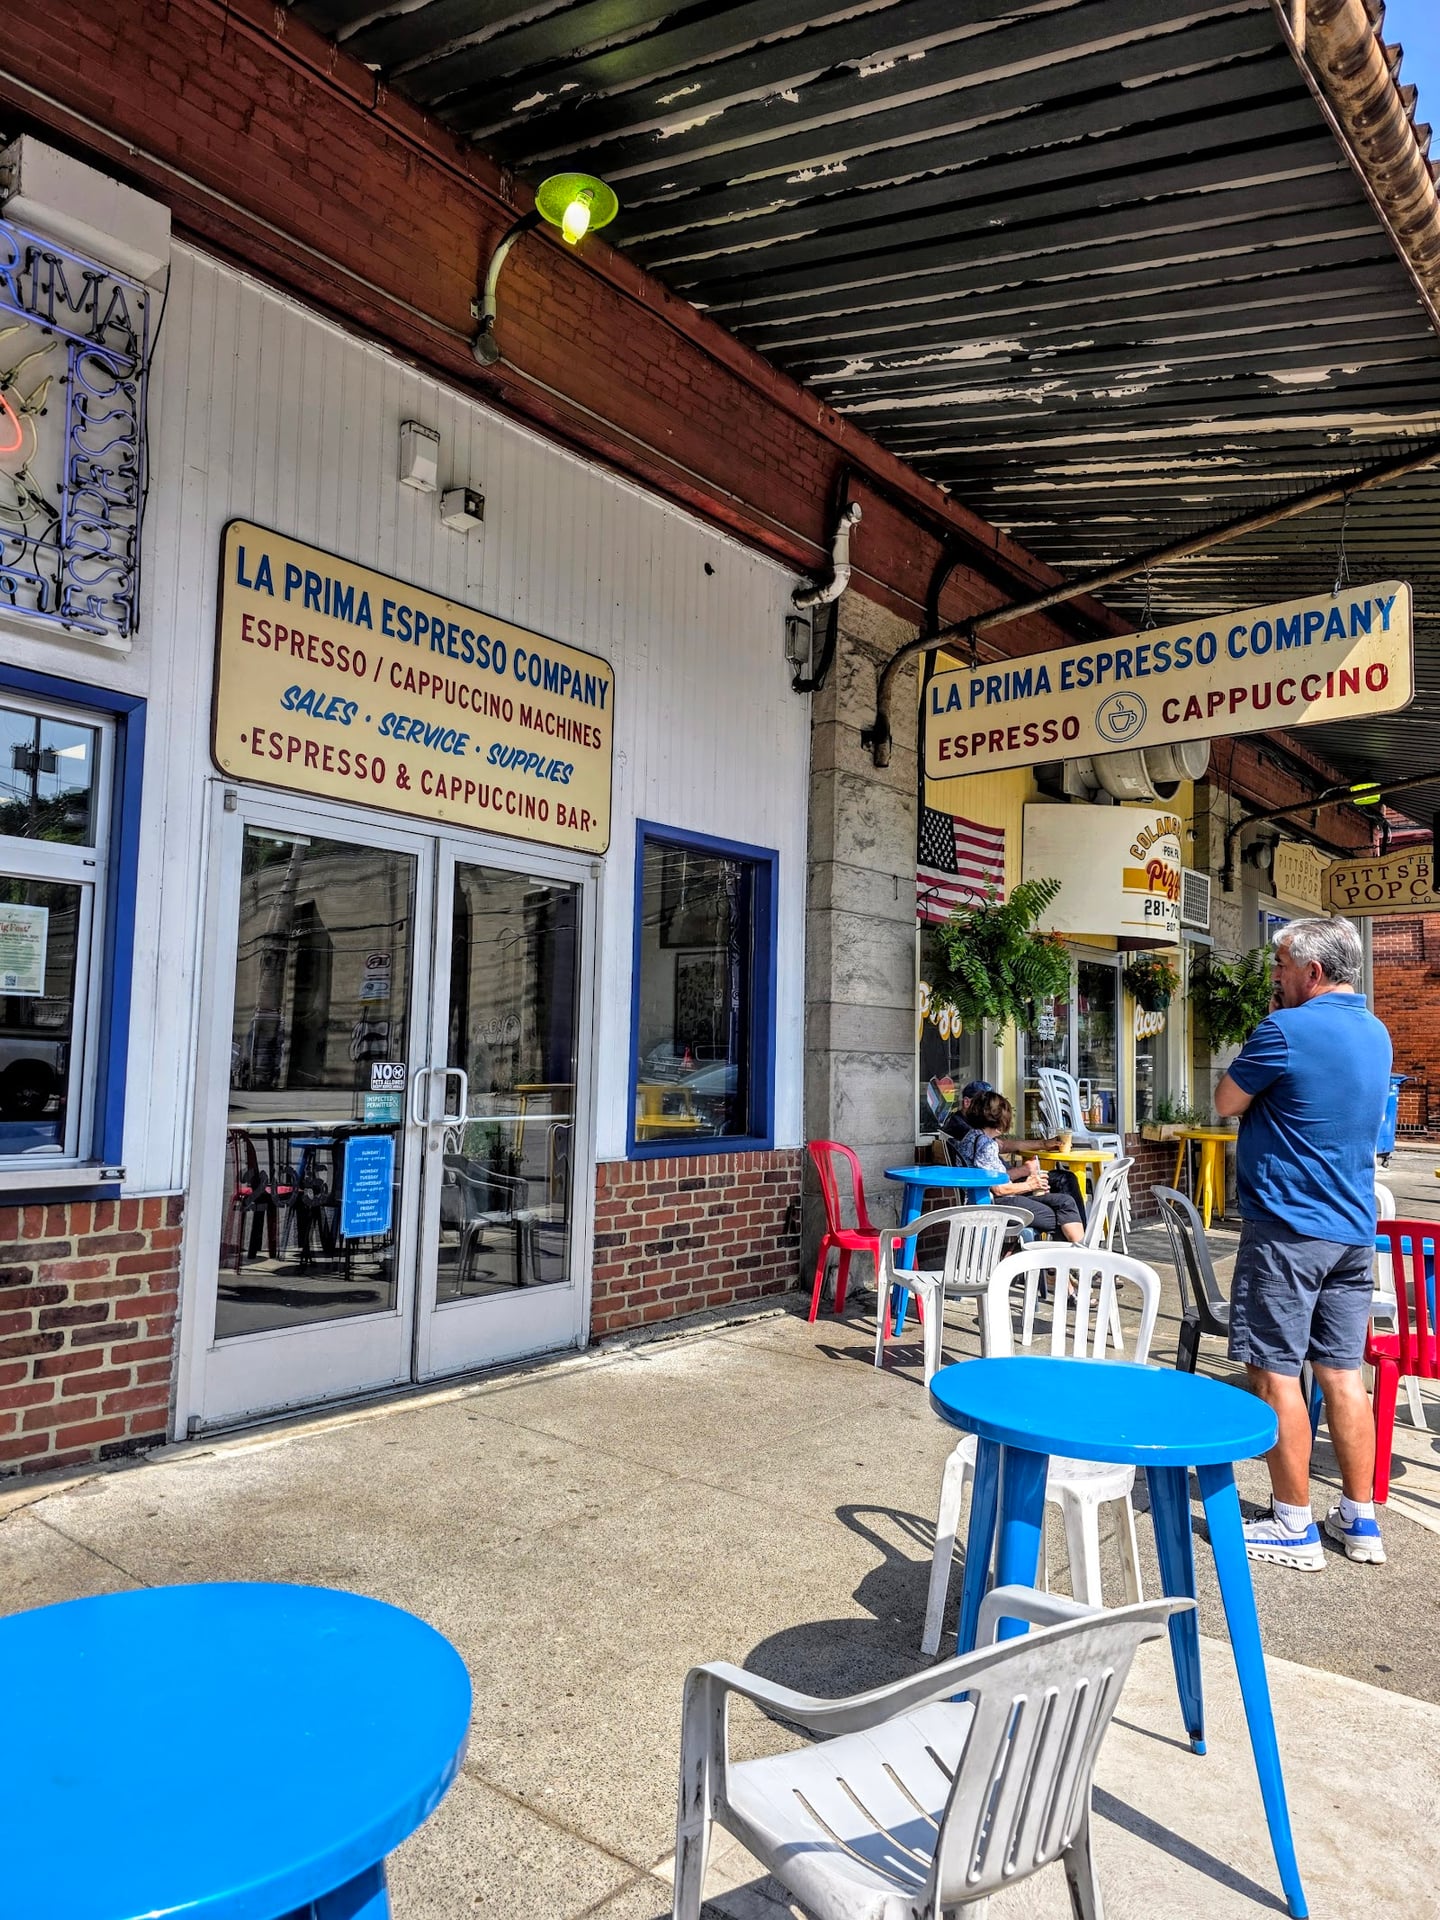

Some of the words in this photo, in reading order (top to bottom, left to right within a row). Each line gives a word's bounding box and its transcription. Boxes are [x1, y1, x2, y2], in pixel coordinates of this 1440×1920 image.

[237, 545, 274, 597] LA
[284, 562, 373, 630] PRIMA
[382, 598, 507, 674] ESPRESSO
[513, 647, 609, 710] COMPANY
[932, 685, 962, 715] LA
[970, 663, 1052, 708] PRIMA
[1060, 631, 1217, 690] ESPRESSO
[1228, 595, 1396, 657] COMPANY
[241, 613, 366, 677] ESPRESSO
[390, 662, 513, 723] CAPPUCCINO
[520, 703, 601, 750] MACHINES
[939, 715, 1080, 761] ESPRESSO
[1162, 662, 1389, 724] CAPPUCCINO
[280, 684, 358, 727] SALES
[378, 712, 471, 757] SERVICE
[487, 743, 574, 785] SUPPLIES
[396, 763, 411, 791] &
[420, 770, 549, 822] CAPPUCCINO
[1335, 864, 1429, 887] PITTSB
[1344, 879, 1428, 905] POPC
[373, 1064, 392, 1080] NO
